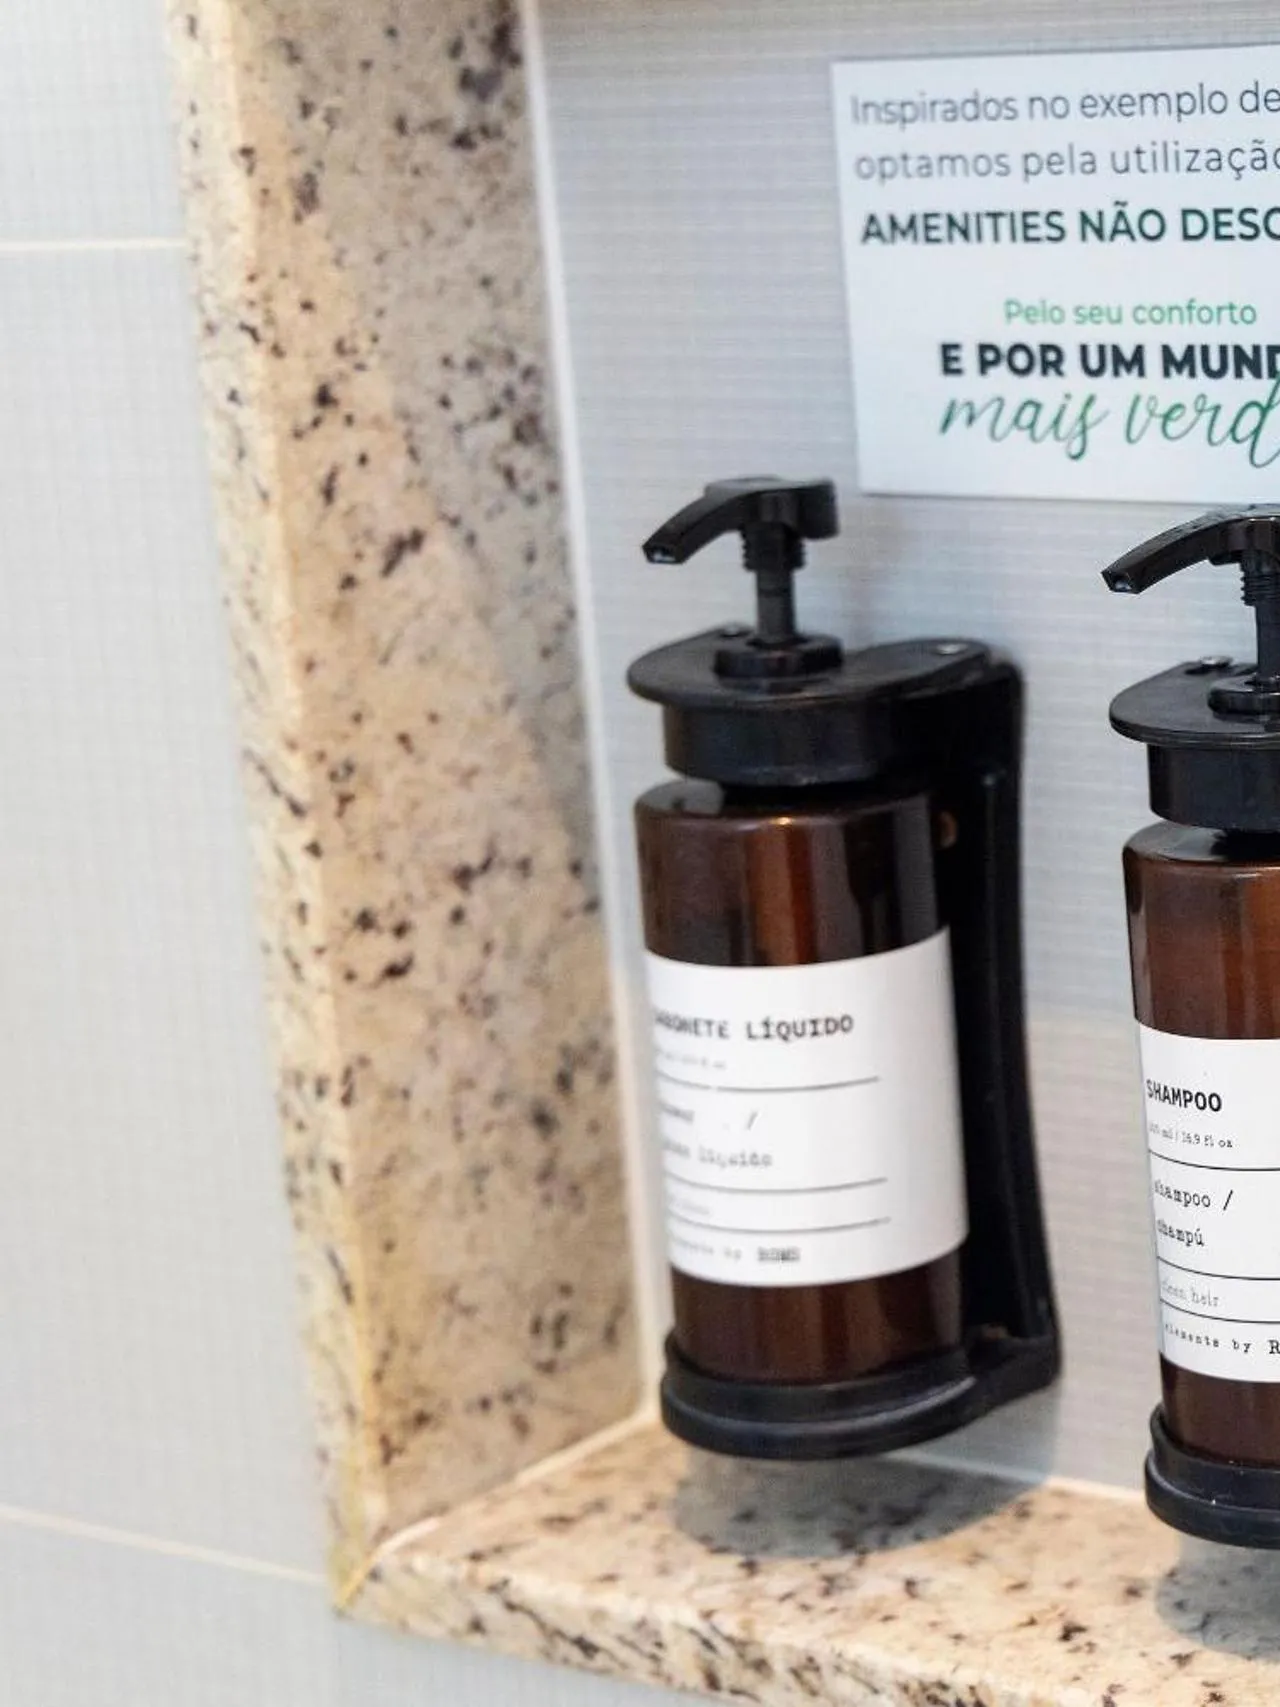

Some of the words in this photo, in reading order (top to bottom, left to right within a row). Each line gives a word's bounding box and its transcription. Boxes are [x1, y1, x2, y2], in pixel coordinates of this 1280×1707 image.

[850, 88, 1017, 131] Inspirados
[1028, 94, 1070, 122] no
[1080, 81, 1228, 122] exemplo
[855, 149, 1010, 182] optamos
[1022, 142, 1097, 181] pela
[860, 210, 1066, 244] AMENITIES
[1080, 200, 1167, 242] NÃO
[1004, 299, 1066, 326] Pelo
[1073, 302, 1123, 326] seu
[1132, 298, 1258, 326] conforto
[940, 342, 964, 377] E
[976, 342, 1066, 378] POR
[1080, 343, 1147, 379] UM
[939, 391, 1110, 461] mais
[654, 1010, 731, 1041] ABONETE
[745, 1014, 855, 1042] LÍQUIDO
[1145, 1078, 1223, 1113] SHAMPOO
[1154, 1178, 1212, 1208] shampoo
[1231, 1337, 1252, 1354] by
